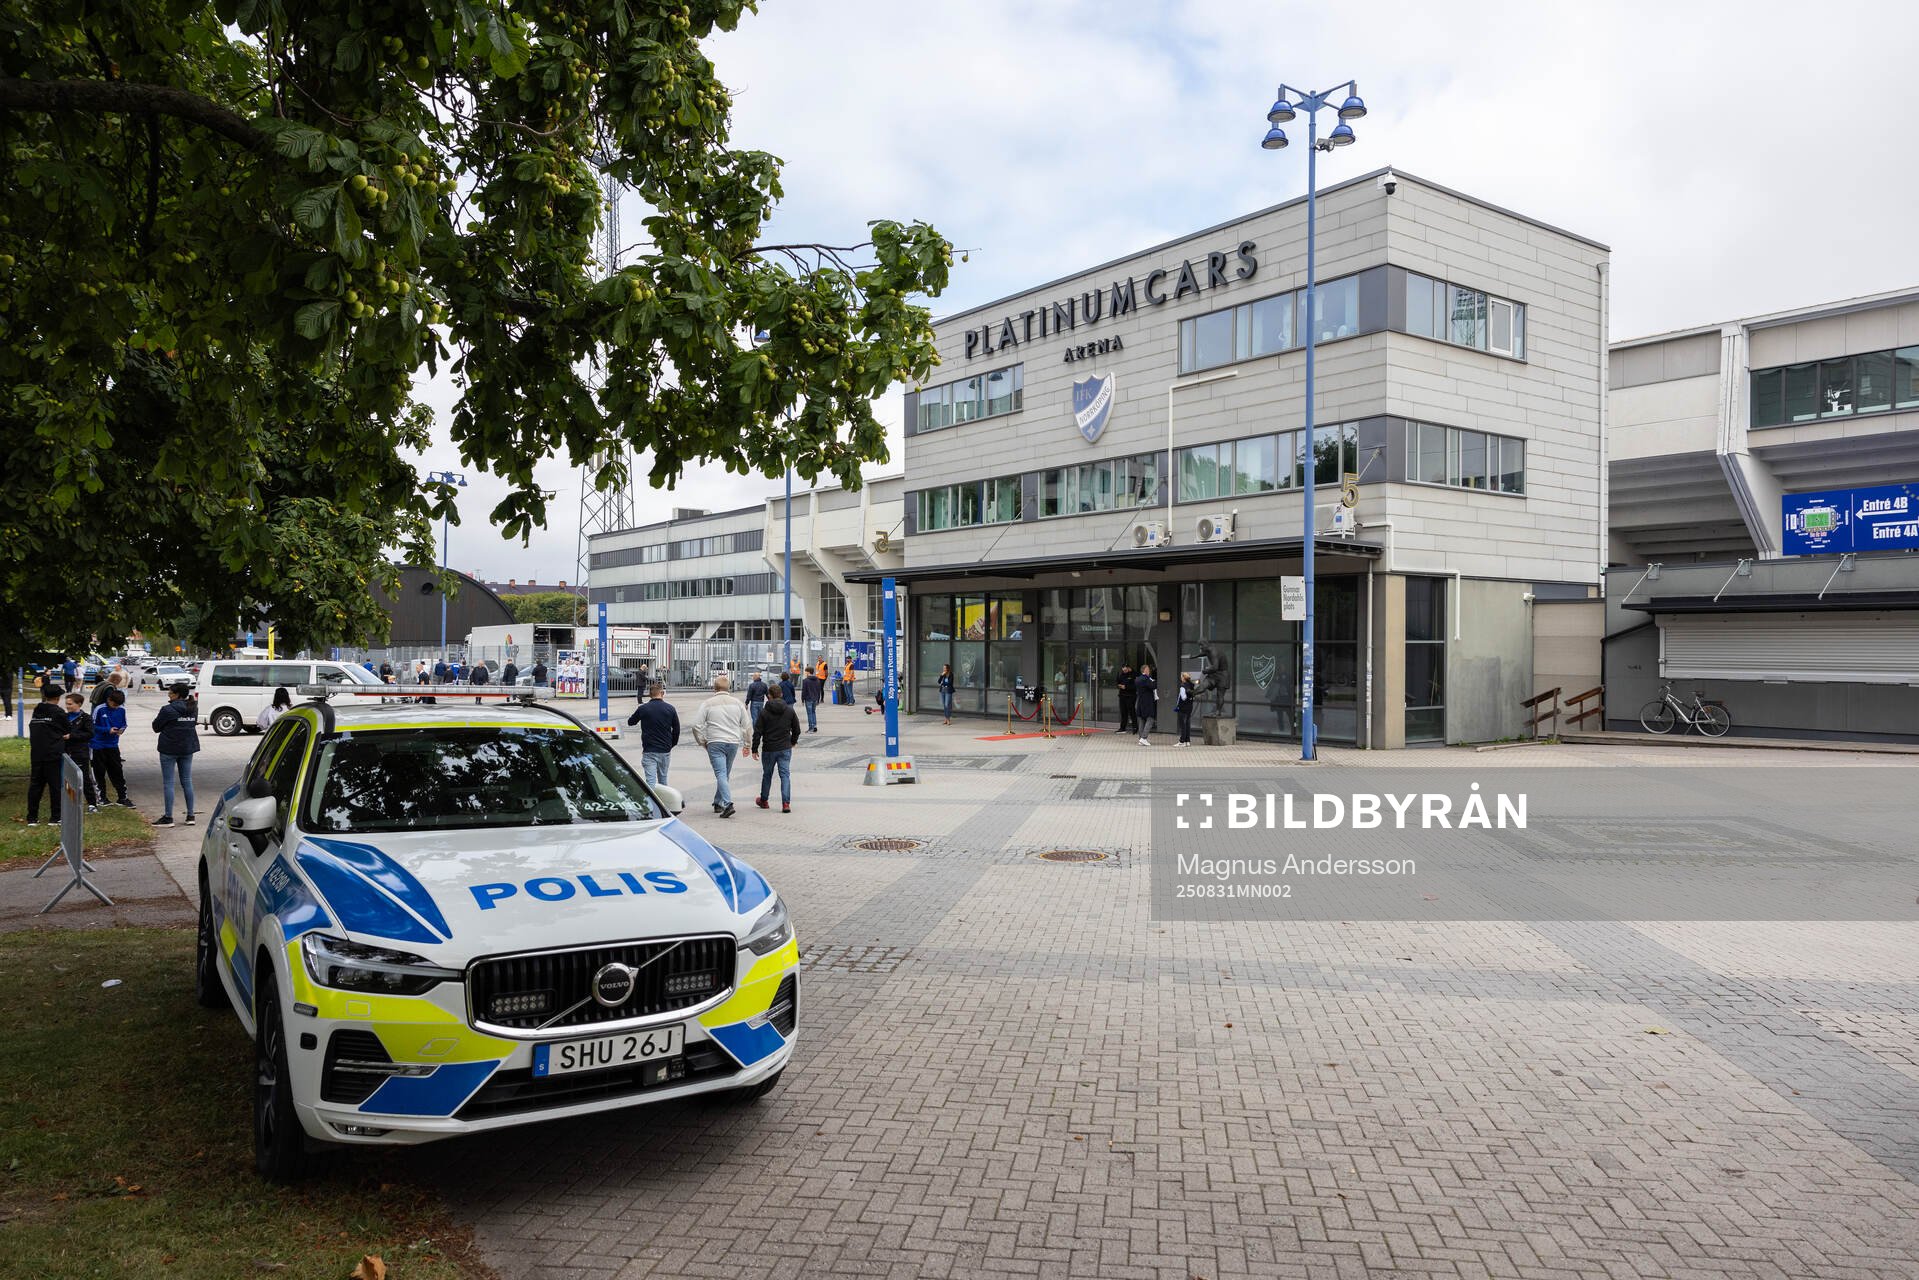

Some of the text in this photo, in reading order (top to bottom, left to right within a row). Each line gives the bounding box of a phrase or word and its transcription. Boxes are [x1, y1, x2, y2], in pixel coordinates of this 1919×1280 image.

[965, 240, 1258, 359] PLATINUMCARS
[1063, 334, 1124, 362] ARENA
[1076, 387, 1092, 401] IFK
[1863, 496, 1908, 512] Entré 4B
[1873, 525, 1918, 539] Entré 4A
[469, 871, 688, 910] POLIS
[600, 981, 630, 990] VOLVO
[560, 1030, 673, 1069] SHU 26J
[538, 1063, 546, 1071] S
